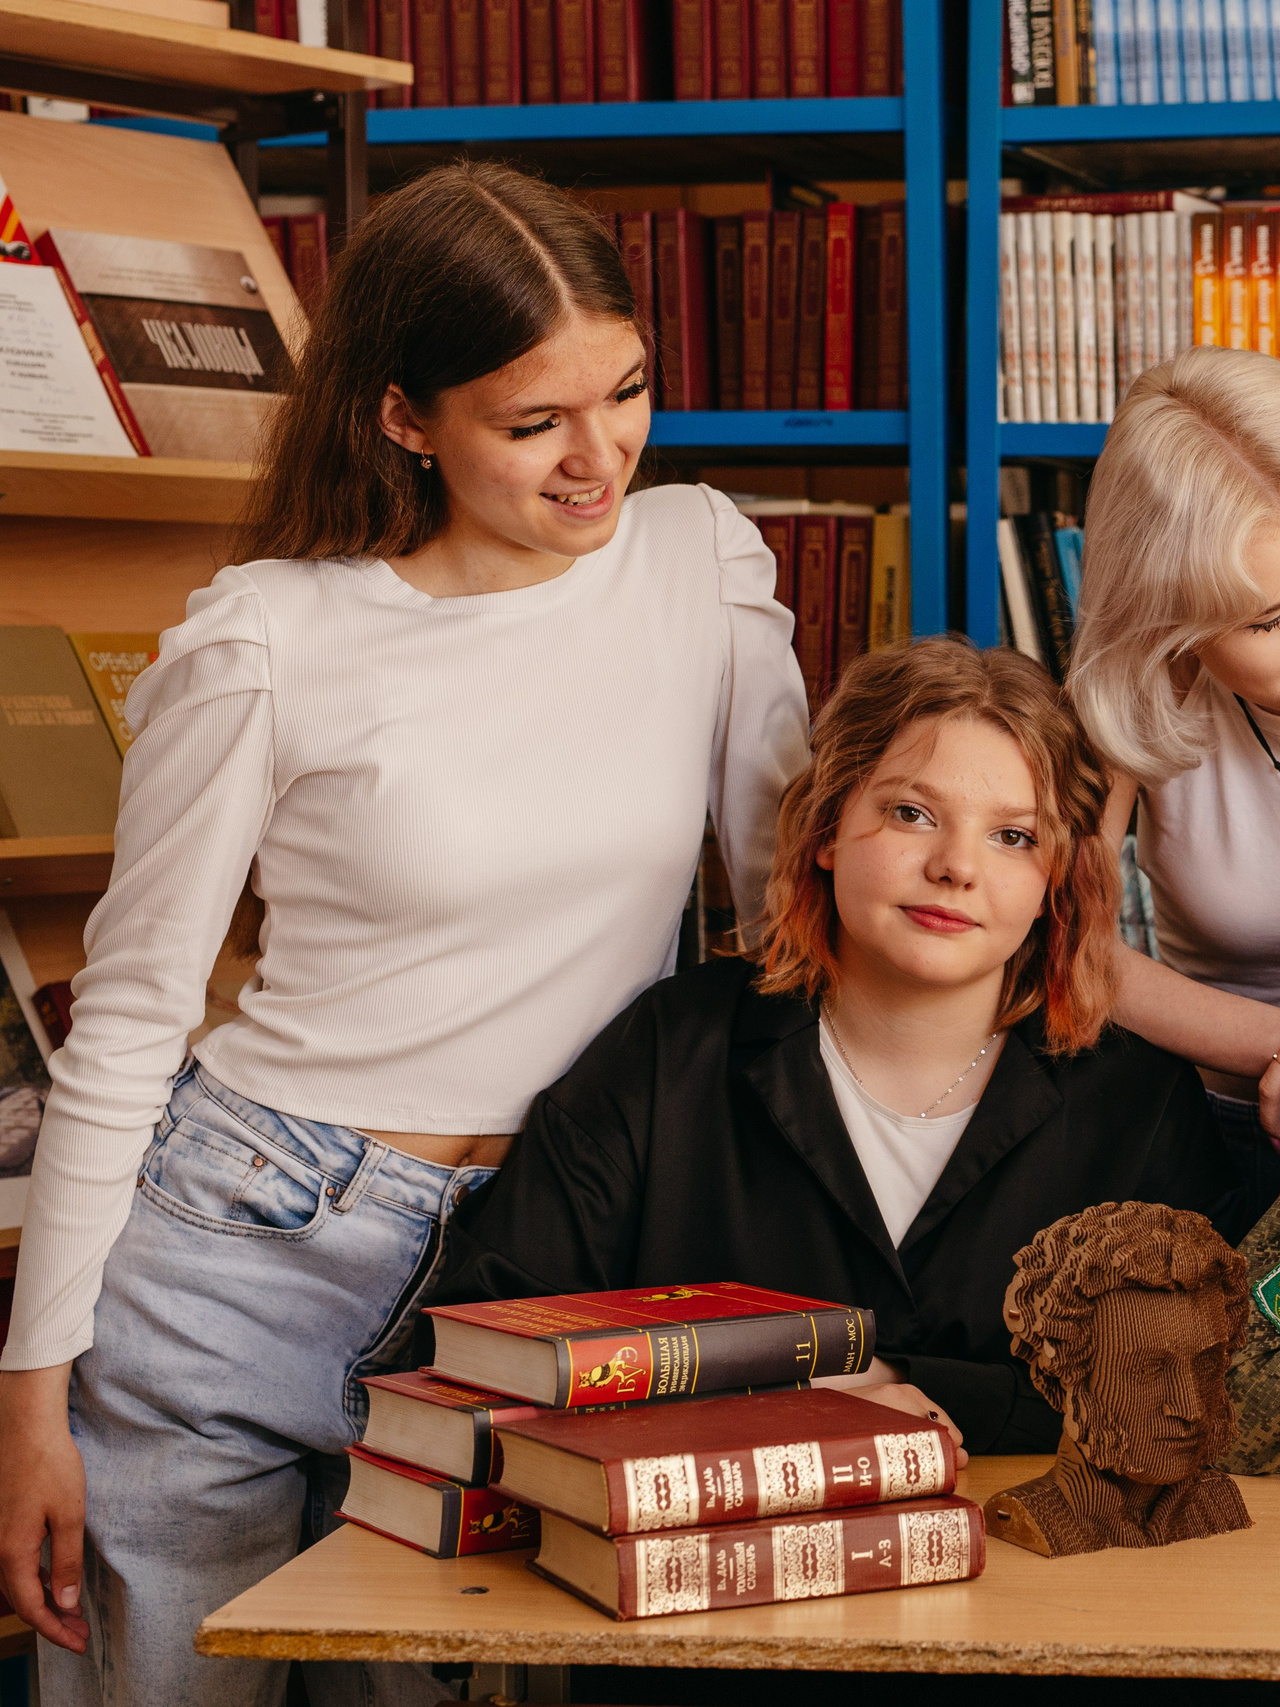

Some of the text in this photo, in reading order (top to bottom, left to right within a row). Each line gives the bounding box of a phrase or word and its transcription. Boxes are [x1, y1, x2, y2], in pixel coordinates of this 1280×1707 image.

[845, 1318, 857, 1341] МОС
[656, 1336, 669, 1395] БОЛЬШАЯ
[669, 1336, 678, 1394] УНИВЕРСАЛЬНАЯ
[678, 1335, 687, 1392] ЭНЦИКЛОПЕДИЯ
[795, 1341, 811, 1362] 11
[843, 1351, 856, 1373] МАН
[703, 1466, 717, 1494] ДАЛЬ
[719, 1458, 734, 1511] ТОЛКОВЫЙ
[732, 1461, 744, 1508] СЛОВАРЬ
[832, 1464, 855, 1485] II
[857, 1456, 873, 1487] И-О
[716, 1549, 727, 1577] ДАЛЬ
[734, 1542, 747, 1595] ТОЛКОВЫЙ
[745, 1544, 757, 1590] СЛОВАРЬ
[851, 1549, 874, 1561] I
